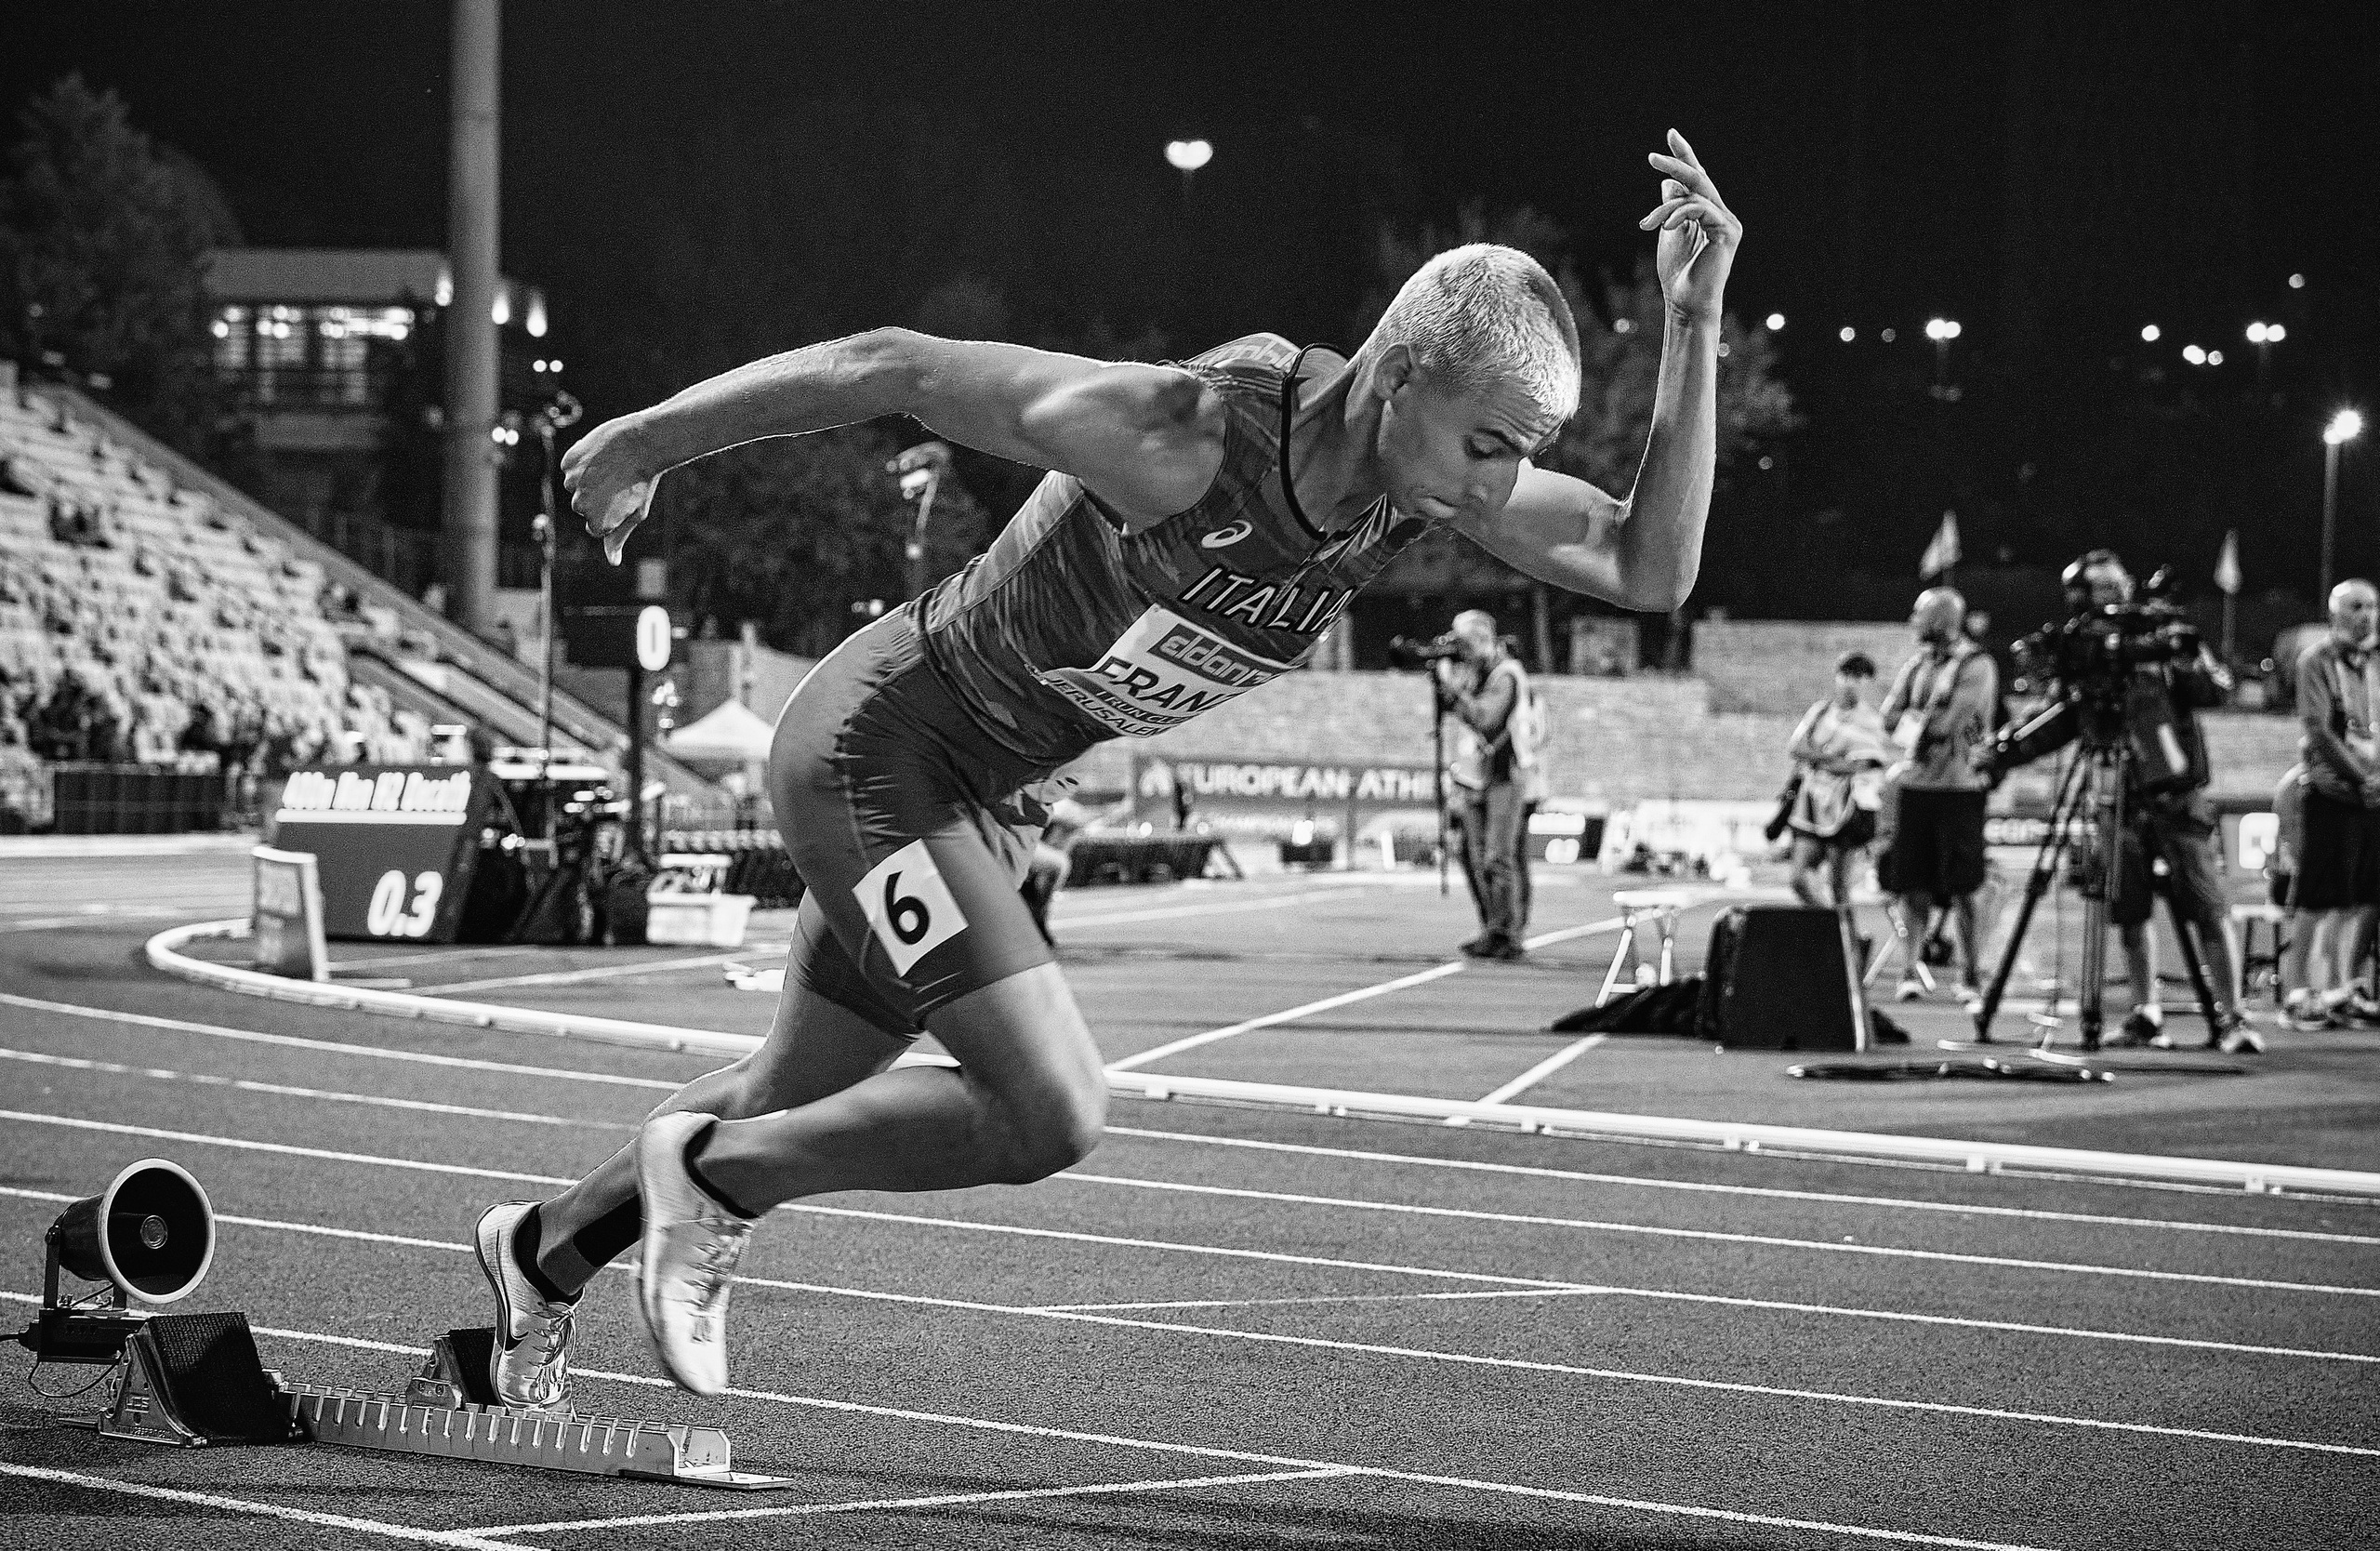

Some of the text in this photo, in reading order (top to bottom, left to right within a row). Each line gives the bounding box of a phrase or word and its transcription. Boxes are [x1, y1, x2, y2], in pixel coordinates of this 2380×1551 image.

[1179, 565, 1355, 633] ITALIA
[636, 605, 670, 670] 0
[1090, 656, 1246, 712] FRAN
[367, 869, 443, 937] 0.3
[885, 870, 931, 946] 6
